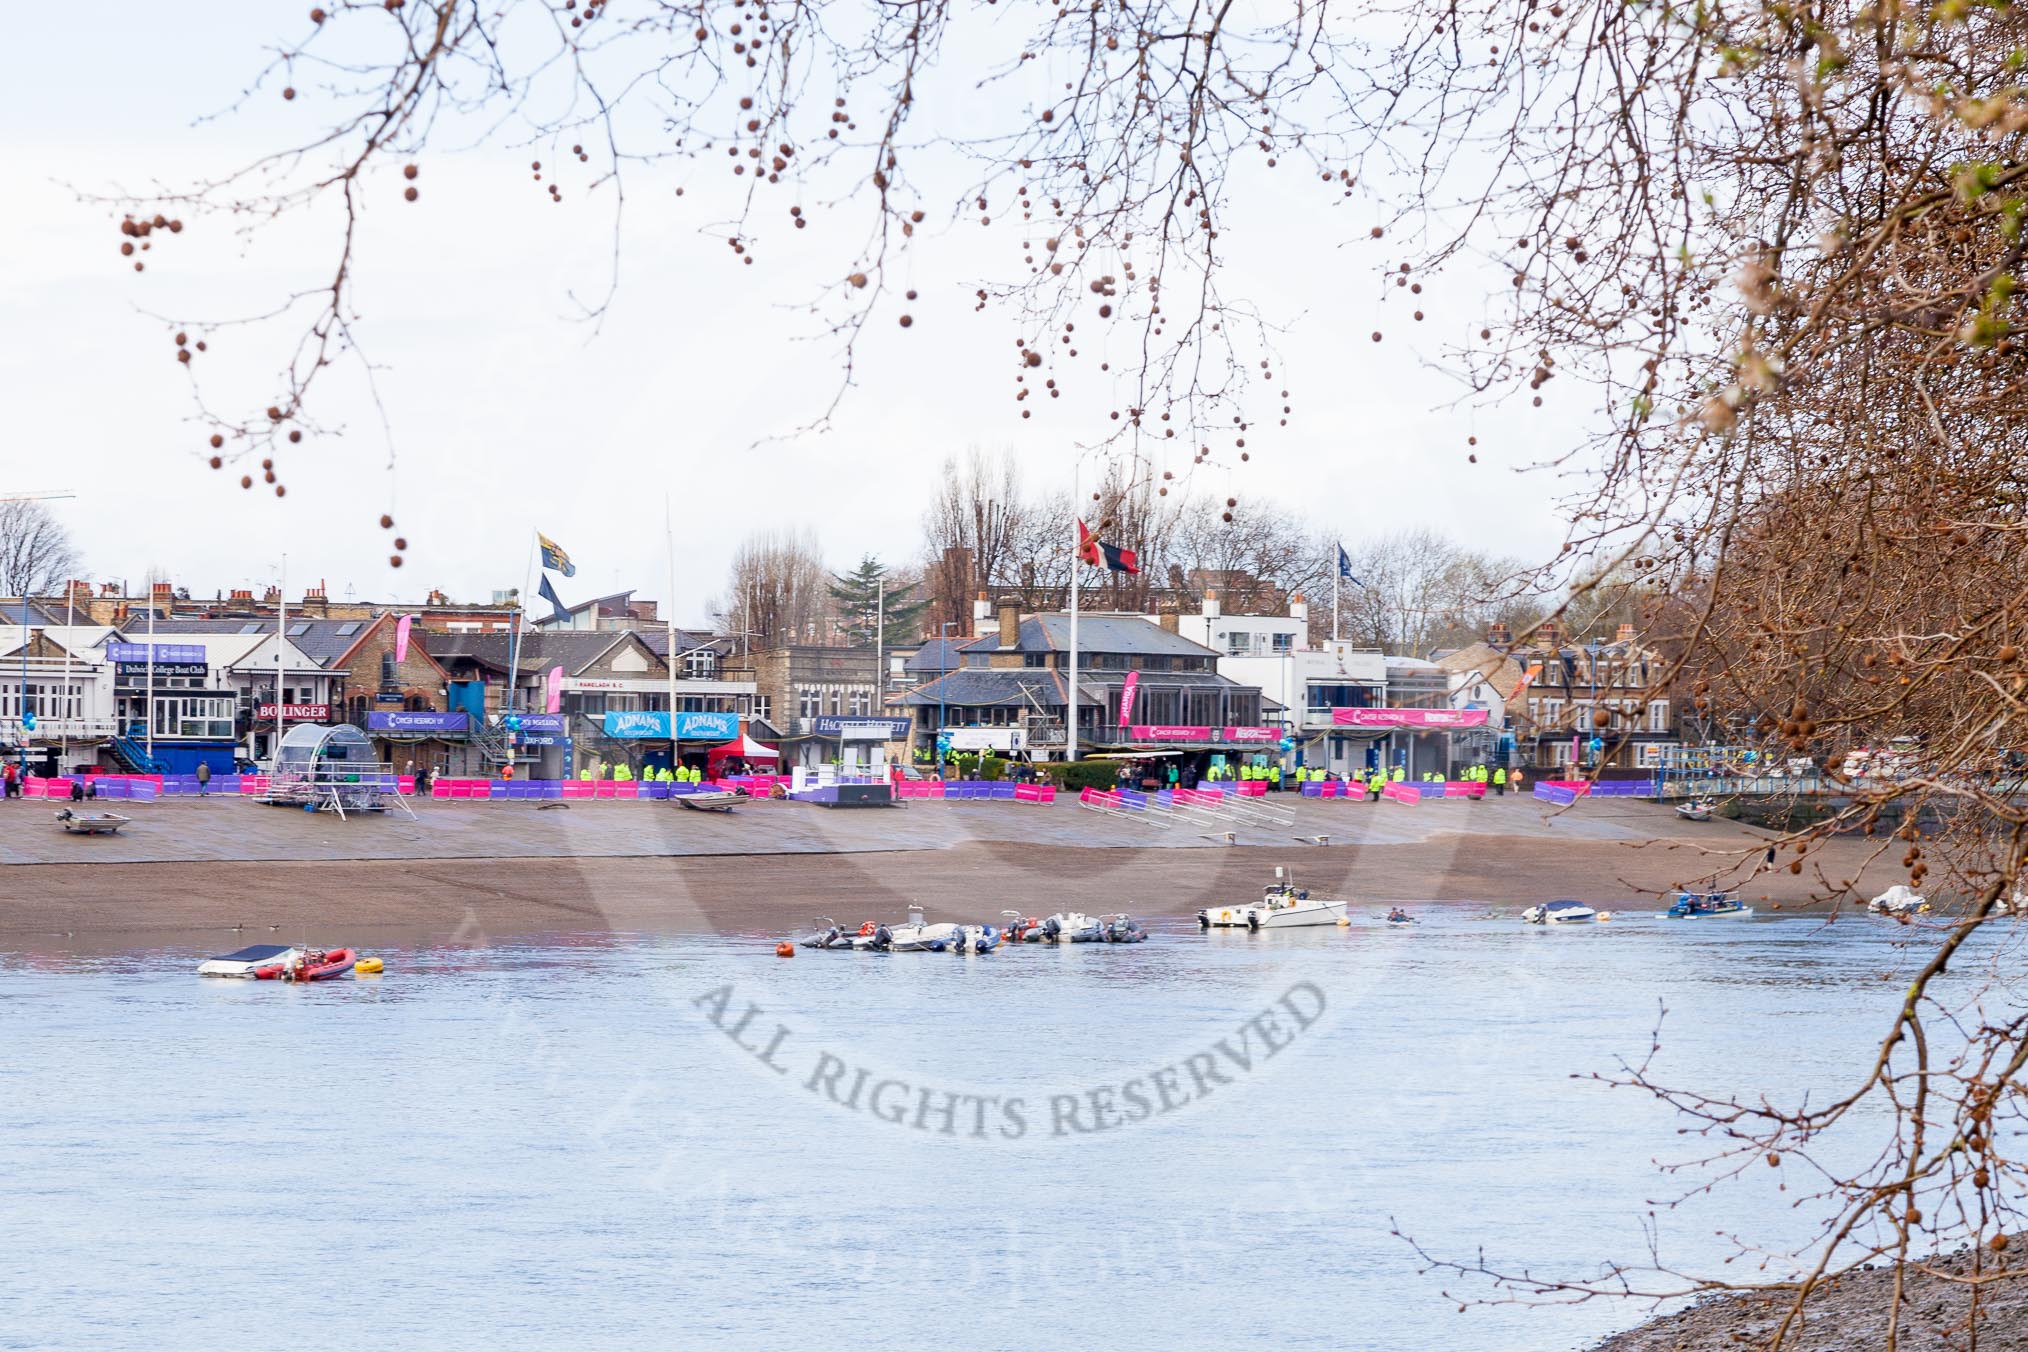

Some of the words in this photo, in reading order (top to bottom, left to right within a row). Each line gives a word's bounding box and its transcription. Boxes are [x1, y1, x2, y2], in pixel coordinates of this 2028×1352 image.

[152, 665, 174, 676] College
[175, 666, 190, 674] Boat
[190, 666, 205, 674] Club
[260, 706, 327, 717] BOLINGER
[615, 714, 662, 734] ADNAMS
[682, 715, 728, 735] ADNAMS
